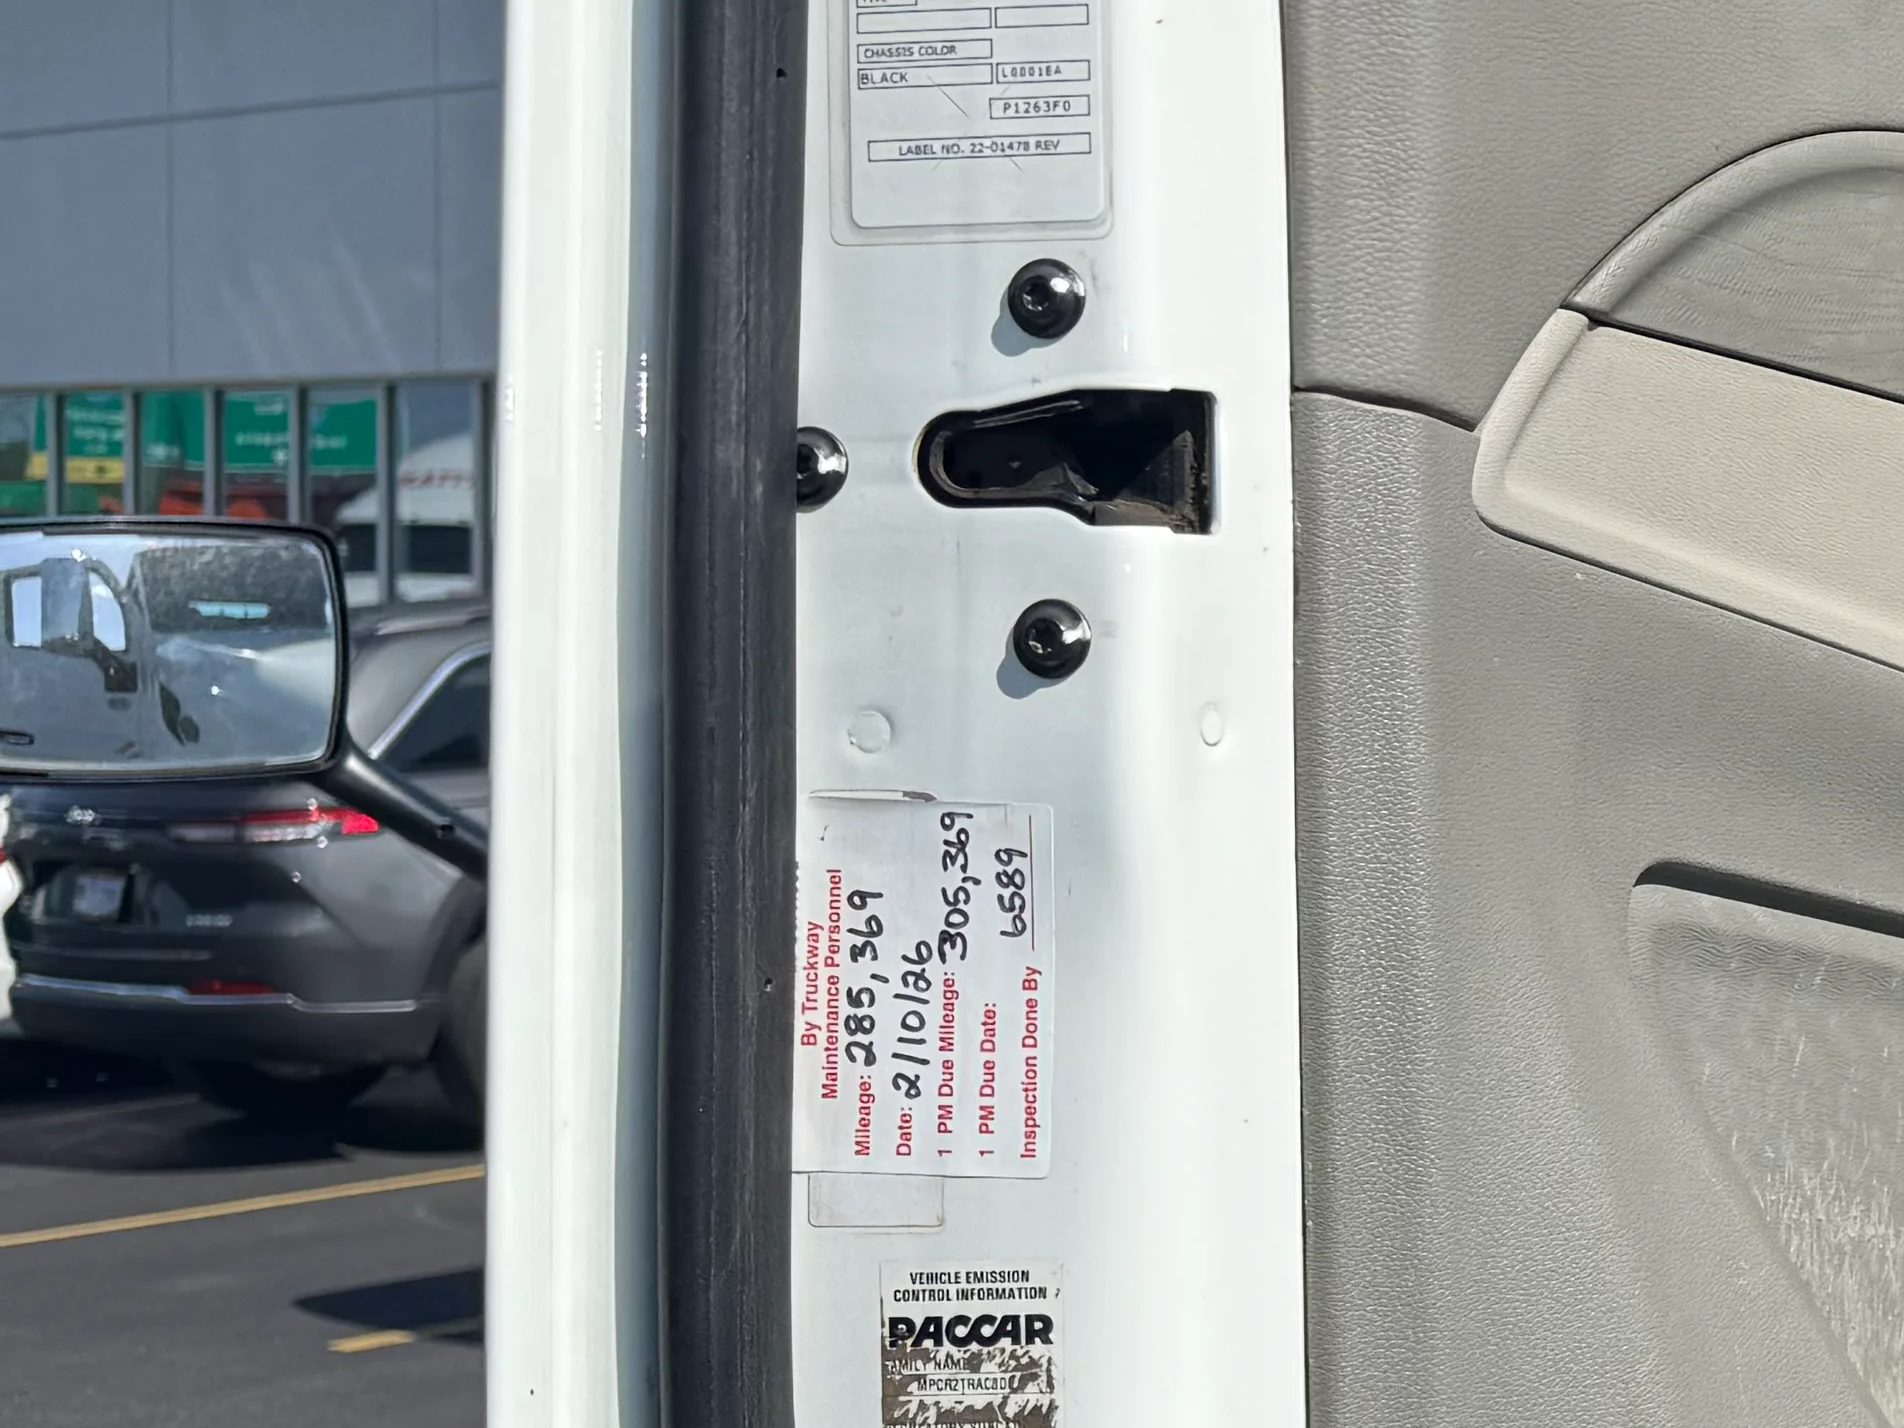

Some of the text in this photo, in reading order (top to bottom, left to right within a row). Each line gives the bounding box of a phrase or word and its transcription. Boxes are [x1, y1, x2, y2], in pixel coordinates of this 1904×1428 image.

[864, 45, 957, 59] CHASSIS COLOR
[860, 72, 908, 85] BLACK
[899, 143, 937, 157] LABEL
[1034, 139, 1061, 151] REV
[801, 921, 824, 1047] By Truckway
[821, 868, 842, 1100] Maintenance Personnel
[938, 972, 961, 1053] Mileage:
[979, 1002, 998, 1053] Date:
[938, 1059, 955, 1099] Due
[979, 1059, 996, 1098] Due
[1020, 966, 1042, 1160] Inspection Done By
[854, 1074, 877, 1157] Mileage:
[896, 1106, 914, 1157] Date:
[937, 1103, 954, 1136] PM
[978, 1104, 996, 1137] PM
[893, 1286, 1048, 1302] CONTROL INFORMATION
[909, 1270, 1030, 1285] VEHICLE EMISSION
[888, 1313, 1054, 1348] PACCAR
